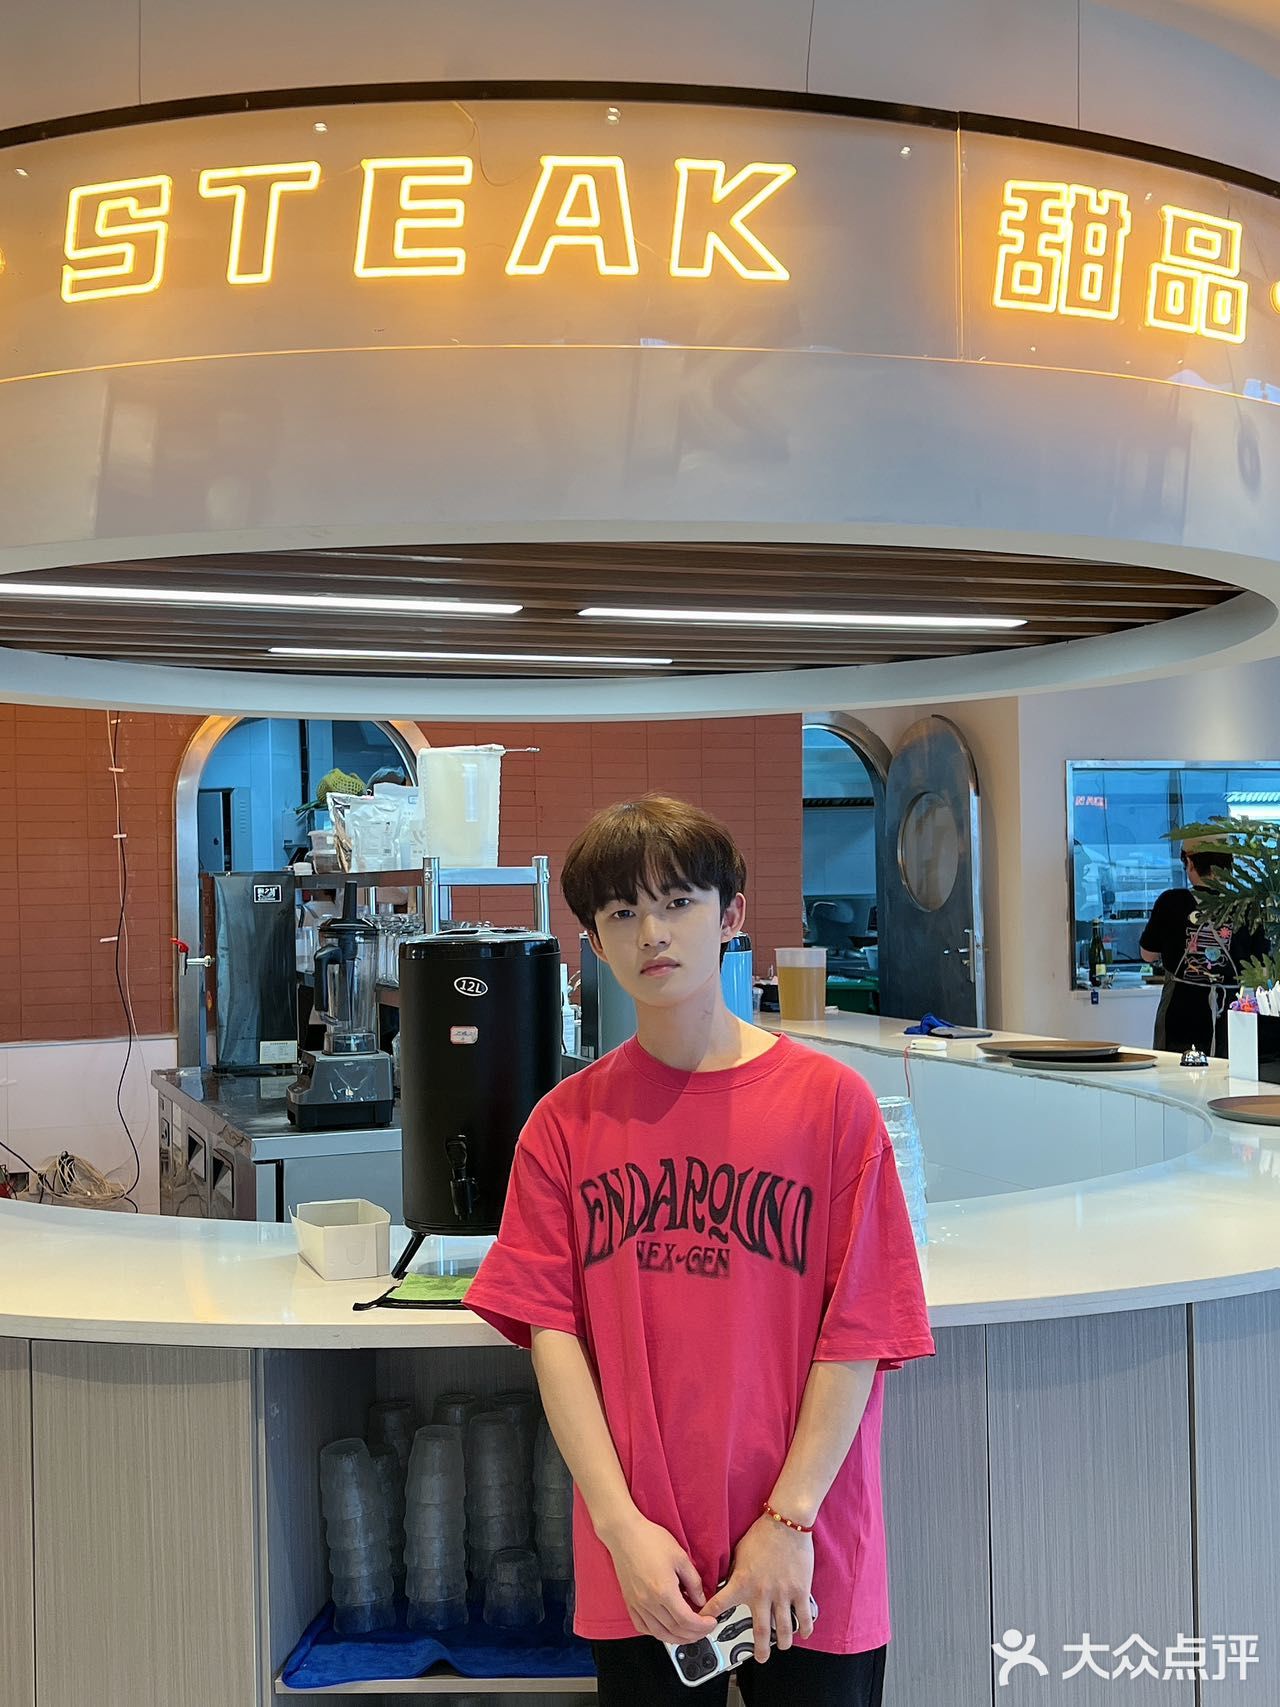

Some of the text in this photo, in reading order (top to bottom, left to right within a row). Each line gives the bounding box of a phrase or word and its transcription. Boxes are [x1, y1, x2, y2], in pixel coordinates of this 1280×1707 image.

[61, 155, 798, 303] STEAK
[993, 179, 1249, 344] 甜品
[459, 980, 482, 994] 12L
[579, 1156, 813, 1276] ENDAROUND
